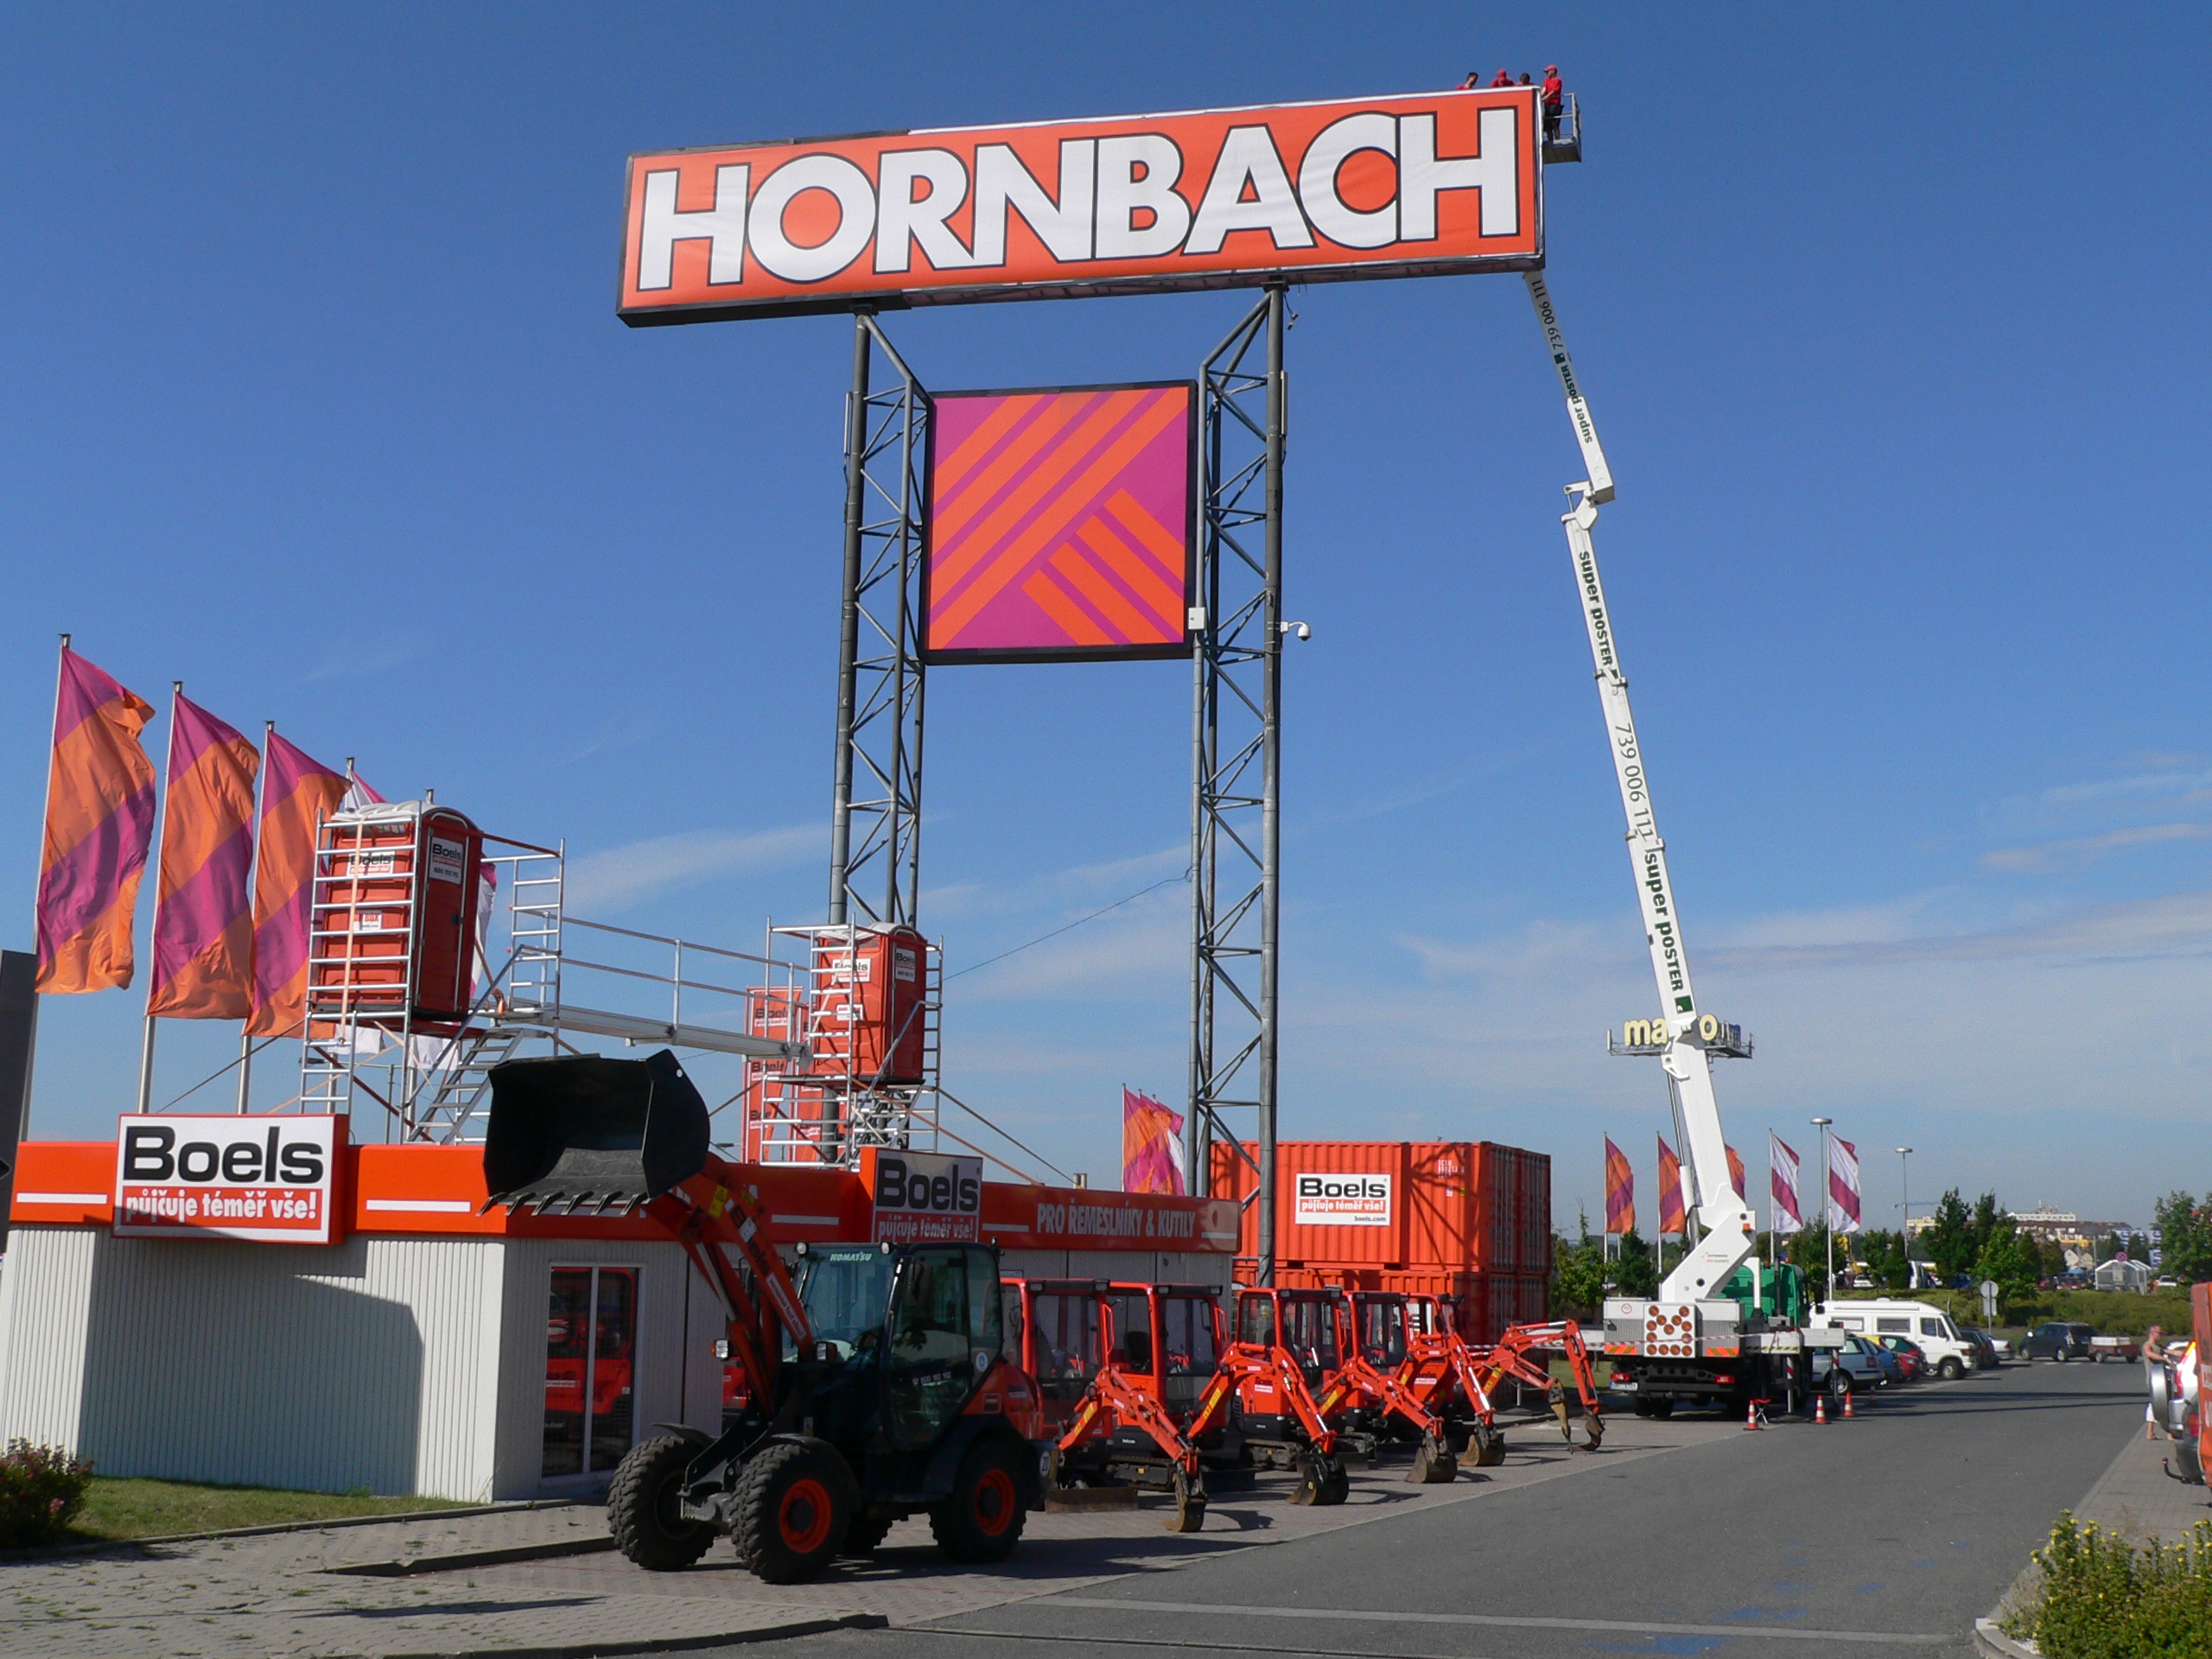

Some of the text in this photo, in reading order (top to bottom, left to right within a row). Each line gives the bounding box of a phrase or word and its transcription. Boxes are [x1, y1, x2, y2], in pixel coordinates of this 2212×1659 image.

[637, 105, 1520, 291] HORNBACH
[1531, 280, 1546, 300] 111
[1539, 302, 1554, 324] 006
[1548, 327, 1564, 350] 739
[1574, 407, 1593, 443] super
[1579, 550, 1599, 603] super
[1615, 722, 1654, 838] 739 006 111
[1644, 852, 1668, 917] super
[1624, 1014, 1719, 1046] mao
[123, 1126, 323, 1184] Boels
[876, 1158, 978, 1212] Boels
[1300, 1177, 1386, 1198] Boels
[126, 1188, 317, 1224] půjčuje téměř vše!
[1037, 1198, 1196, 1238] PRO ŘEMESLNÍKY & KUTILY
[1301, 1198, 1384, 1212] půjčuje téměř vše!
[879, 1214, 974, 1243] půjčuje téměř vše!
[830, 1251, 873, 1262] KOMATSU
